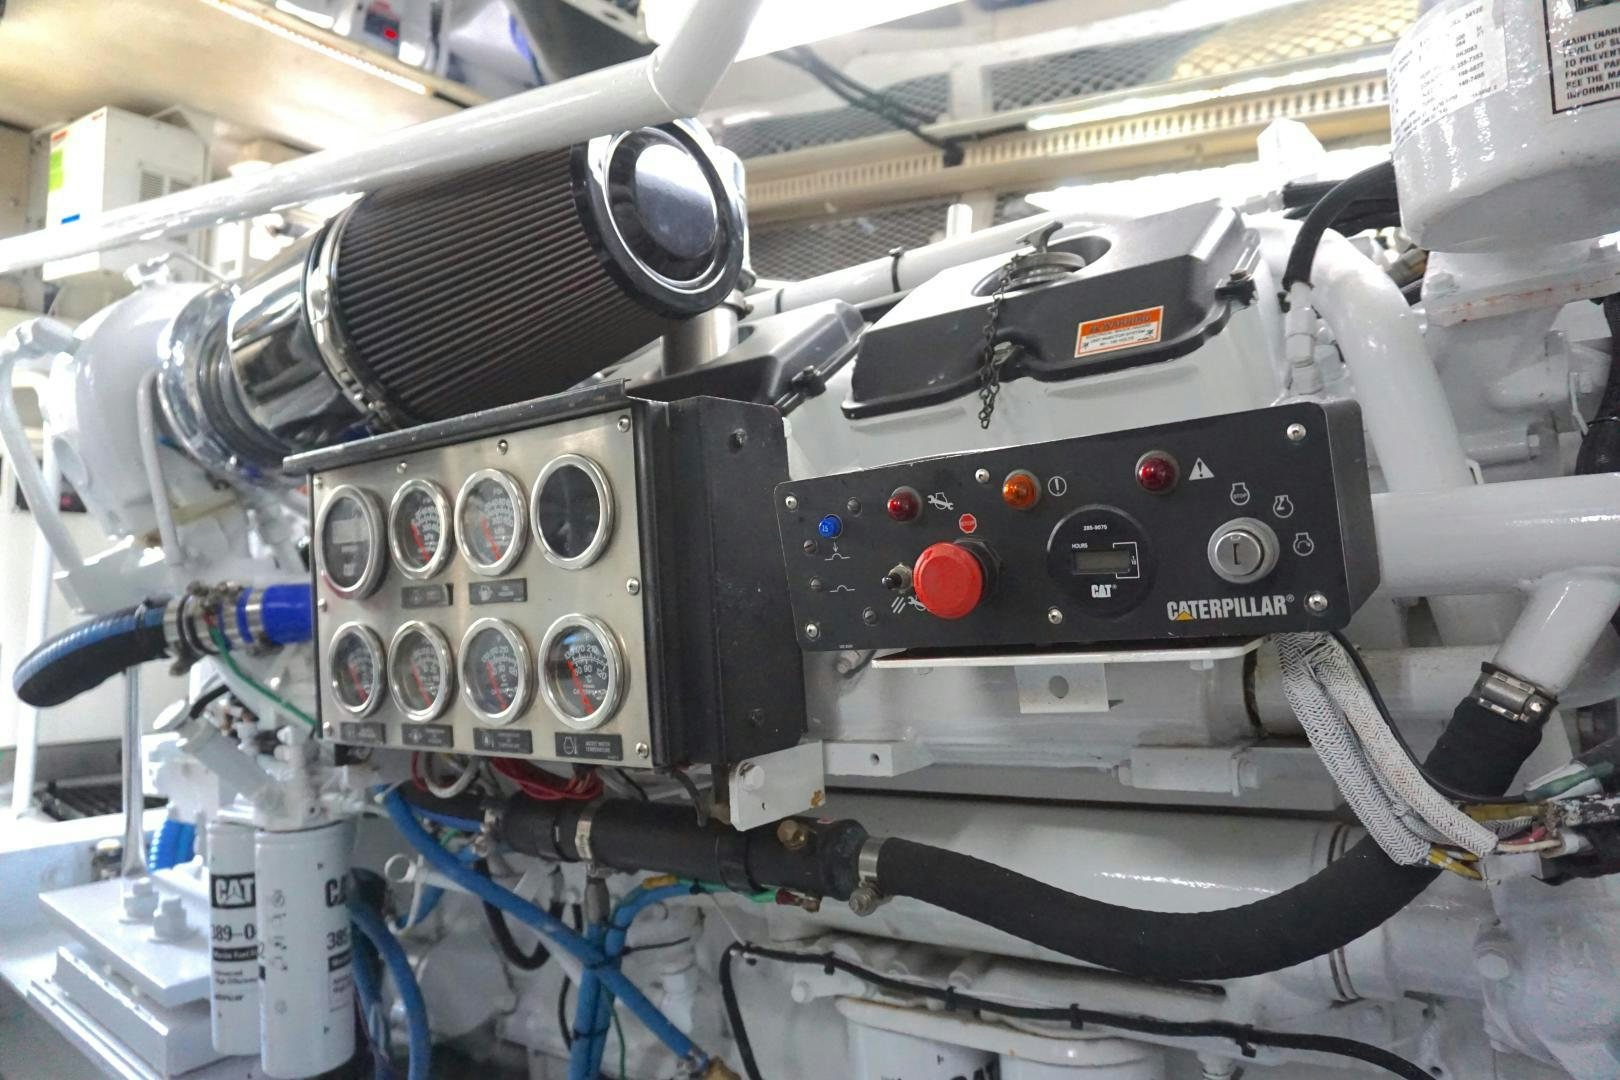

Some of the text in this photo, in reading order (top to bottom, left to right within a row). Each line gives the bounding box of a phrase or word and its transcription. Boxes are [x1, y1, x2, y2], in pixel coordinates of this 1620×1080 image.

[1565, 60, 1577, 68] TO
[1565, 64, 1600, 79] ENGINE
[1587, 74, 1603, 84] THE
[1567, 80, 1620, 99] INFORMATI
[214, 877, 256, 907] CAT
